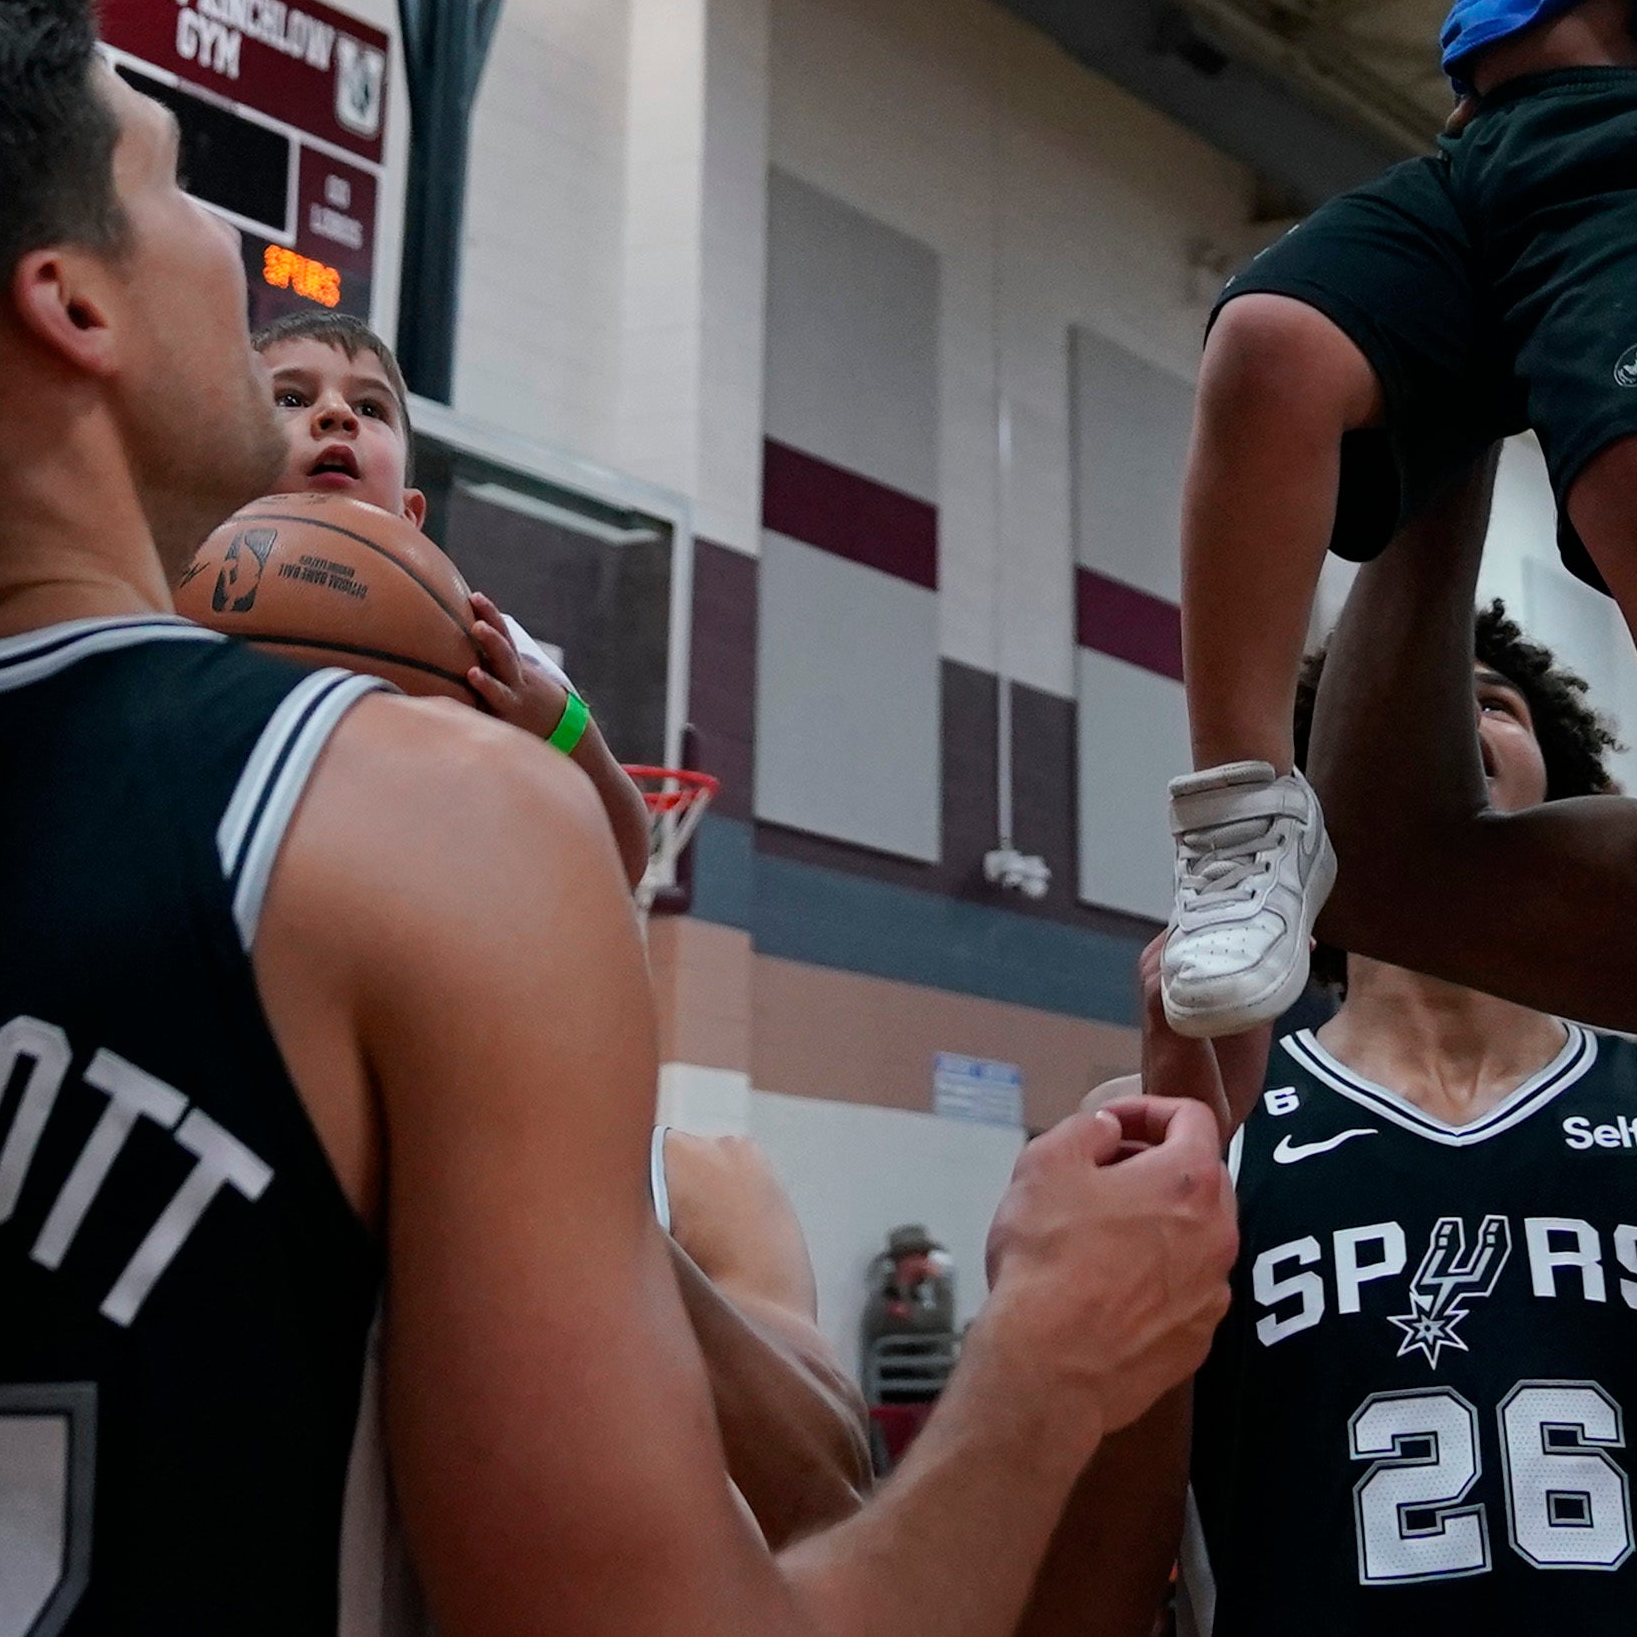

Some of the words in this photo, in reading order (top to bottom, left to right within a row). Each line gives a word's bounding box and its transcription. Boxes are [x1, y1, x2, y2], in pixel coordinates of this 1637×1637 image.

[175, 7, 242, 80] GYM
[1263, 1086, 1300, 1117] 6
[1347, 1378, 1637, 1585] 26
